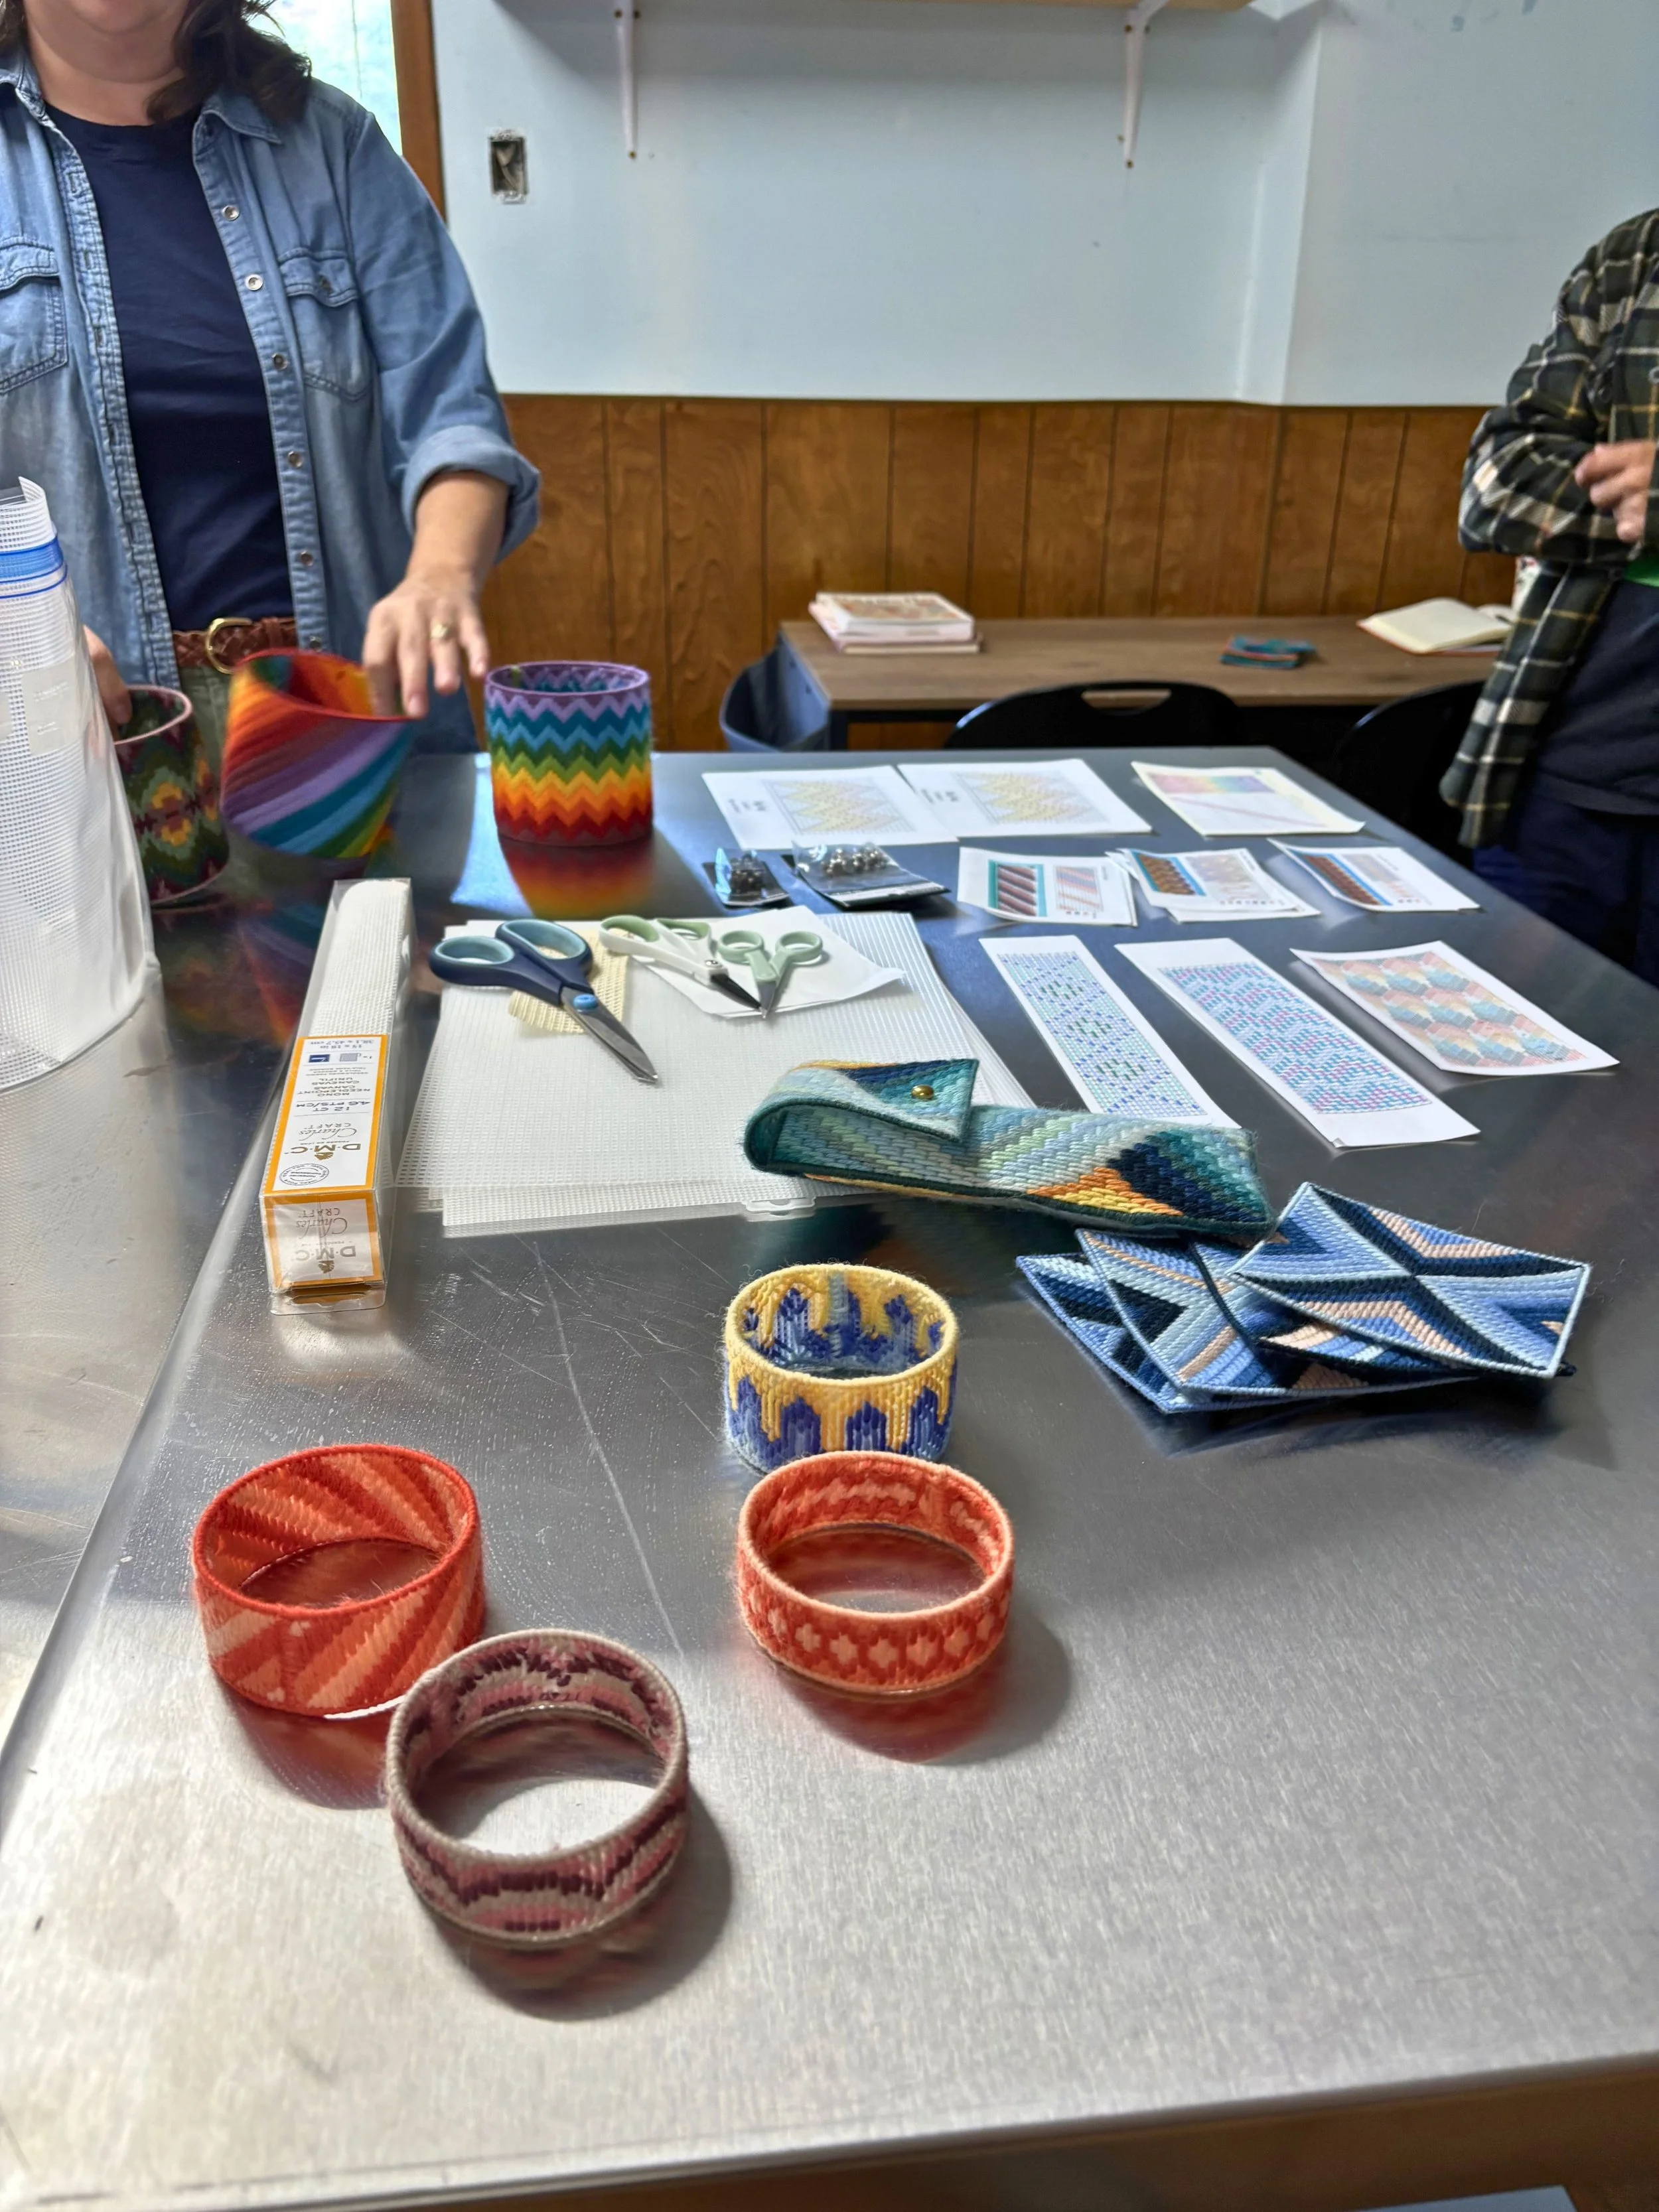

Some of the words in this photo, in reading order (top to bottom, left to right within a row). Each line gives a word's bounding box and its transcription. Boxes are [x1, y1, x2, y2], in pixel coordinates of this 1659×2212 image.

[298, 1127, 358, 1141] Charles
[302, 1208, 340, 1218] CRAFT
[296, 1217, 348, 1239] Charles
